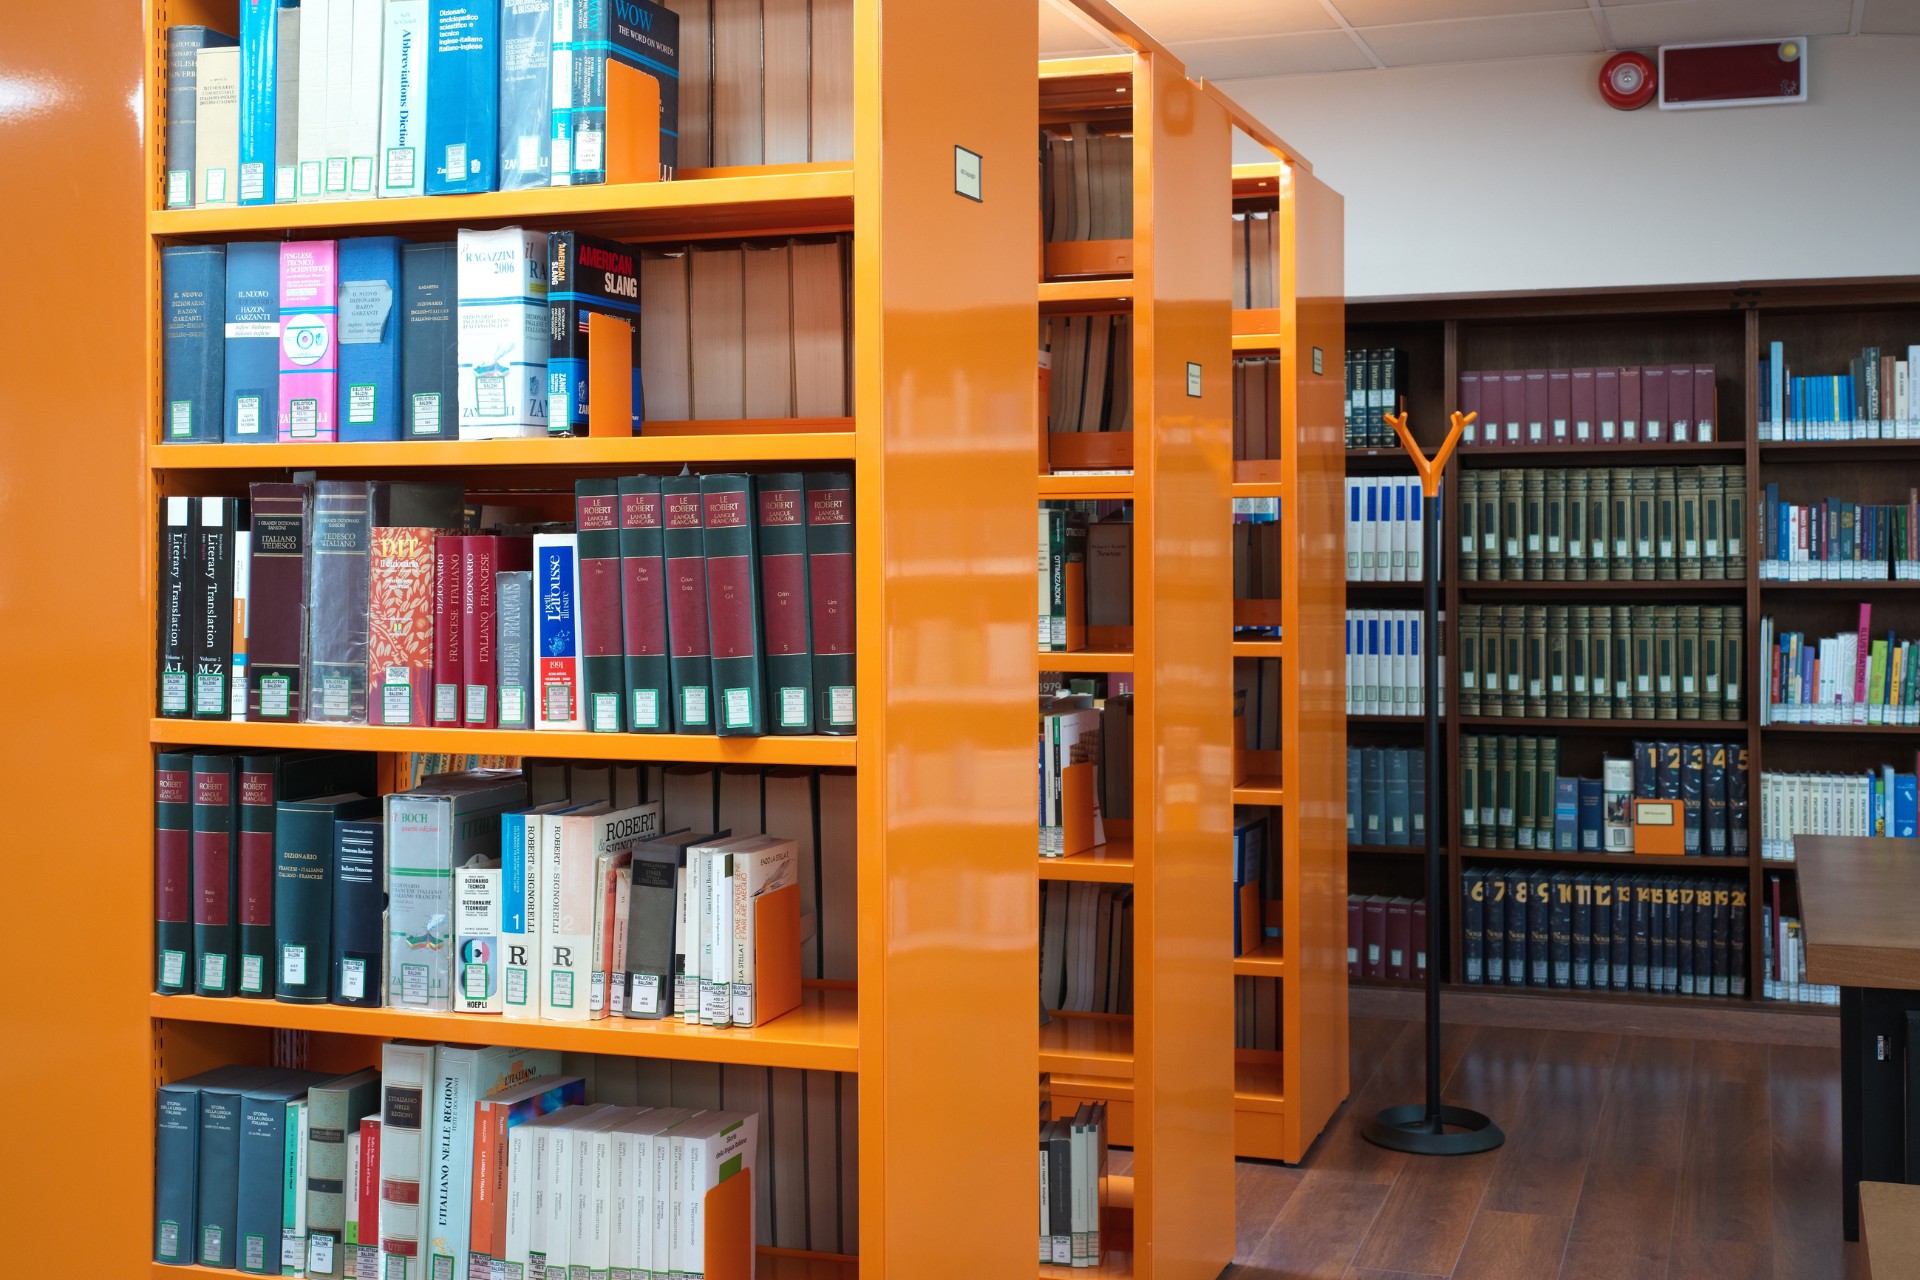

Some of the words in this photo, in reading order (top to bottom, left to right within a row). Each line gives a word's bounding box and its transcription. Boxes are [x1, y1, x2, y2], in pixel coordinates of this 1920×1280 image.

[440, 15, 479, 23] enciclopedico
[614, 0, 654, 32] WOW
[440, 23, 467, 31] scientifico
[619, 25, 629, 38] THE
[630, 30, 647, 45] WORD
[647, 38, 655, 48] ON
[656, 40, 674, 56] WORDS
[401, 30, 412, 107] Abbreviations
[466, 251, 515, 262] RAGAZZINI
[525, 243, 534, 259] il
[579, 246, 633, 276] AMERICAN
[494, 263, 515, 274] 2006
[558, 243, 566, 282] AMERICAN
[605, 272, 637, 298] SLANG
[584, 506, 612, 515] ROBERT
[627, 504, 654, 513] ROBERT
[636, 497, 644, 505] LE
[671, 504, 698, 513] ROBERT
[710, 503, 739, 512] ROBERT
[766, 501, 794, 510] ROBERT
[815, 500, 844, 509] ROBERT
[323, 540, 356, 548] ITALIANO
[381, 539, 419, 558] DIT
[171, 533, 183, 580] Literary
[206, 534, 218, 580] Literary
[436, 554, 445, 614] DIZIONARIO
[451, 554, 460, 605] ITALIANO
[466, 553, 474, 614] DIZIONARIO
[481, 553, 490, 607] FRANCESE
[548, 555, 561, 622] Larousse
[171, 582, 182, 647] Translation
[206, 583, 218, 648] Translation
[450, 609, 459, 662] FRANCESE
[480, 612, 489, 663] ITALIANO
[503, 643, 521, 686] DUDEN
[1858, 628, 1868, 683] ILLUSTRATION
[165, 663, 185, 673] A-L
[199, 664, 223, 674] M-Z
[1648, 748, 1657, 769] 1
[1668, 749, 1680, 769] 2
[1692, 749, 1703, 770] 3
[1713, 749, 1726, 770] 4
[1739, 750, 1749, 770] 5
[200, 783, 223, 791] ROBERT
[244, 783, 267, 791] ROBERT
[402, 813, 429, 824] BOCH
[606, 812, 656, 842] ROBERT
[528, 826, 536, 865] ROBERT
[1472, 882, 1484, 902] 6
[1495, 882, 1506, 902] 7
[1516, 883, 1527, 903] 8
[1576, 885, 1591, 905] 11
[1594, 885, 1611, 906] 12
[1617, 887, 1630, 902] 13
[1637, 888, 1650, 902] 14
[1651, 889, 1664, 904] 15
[1666, 889, 1678, 905] 16
[1680, 889, 1694, 904] 17
[1696, 891, 1712, 906] 18
[1714, 891, 1728, 906] 19
[528, 873, 536, 934] SIGNORELLI
[513, 914, 520, 930] 1
[563, 916, 574, 931] 2
[510, 946, 527, 966] R
[554, 947, 572, 967] R
[467, 1001, 488, 1009] HOEPLI
[444, 1077, 453, 1123] REGIONI
[391, 1111, 413, 1119] REGIONI
[442, 1127, 451, 1161] NELLE
[439, 1165, 450, 1226] L'ITALIANO
[388, 1243, 407, 1251] UTET
